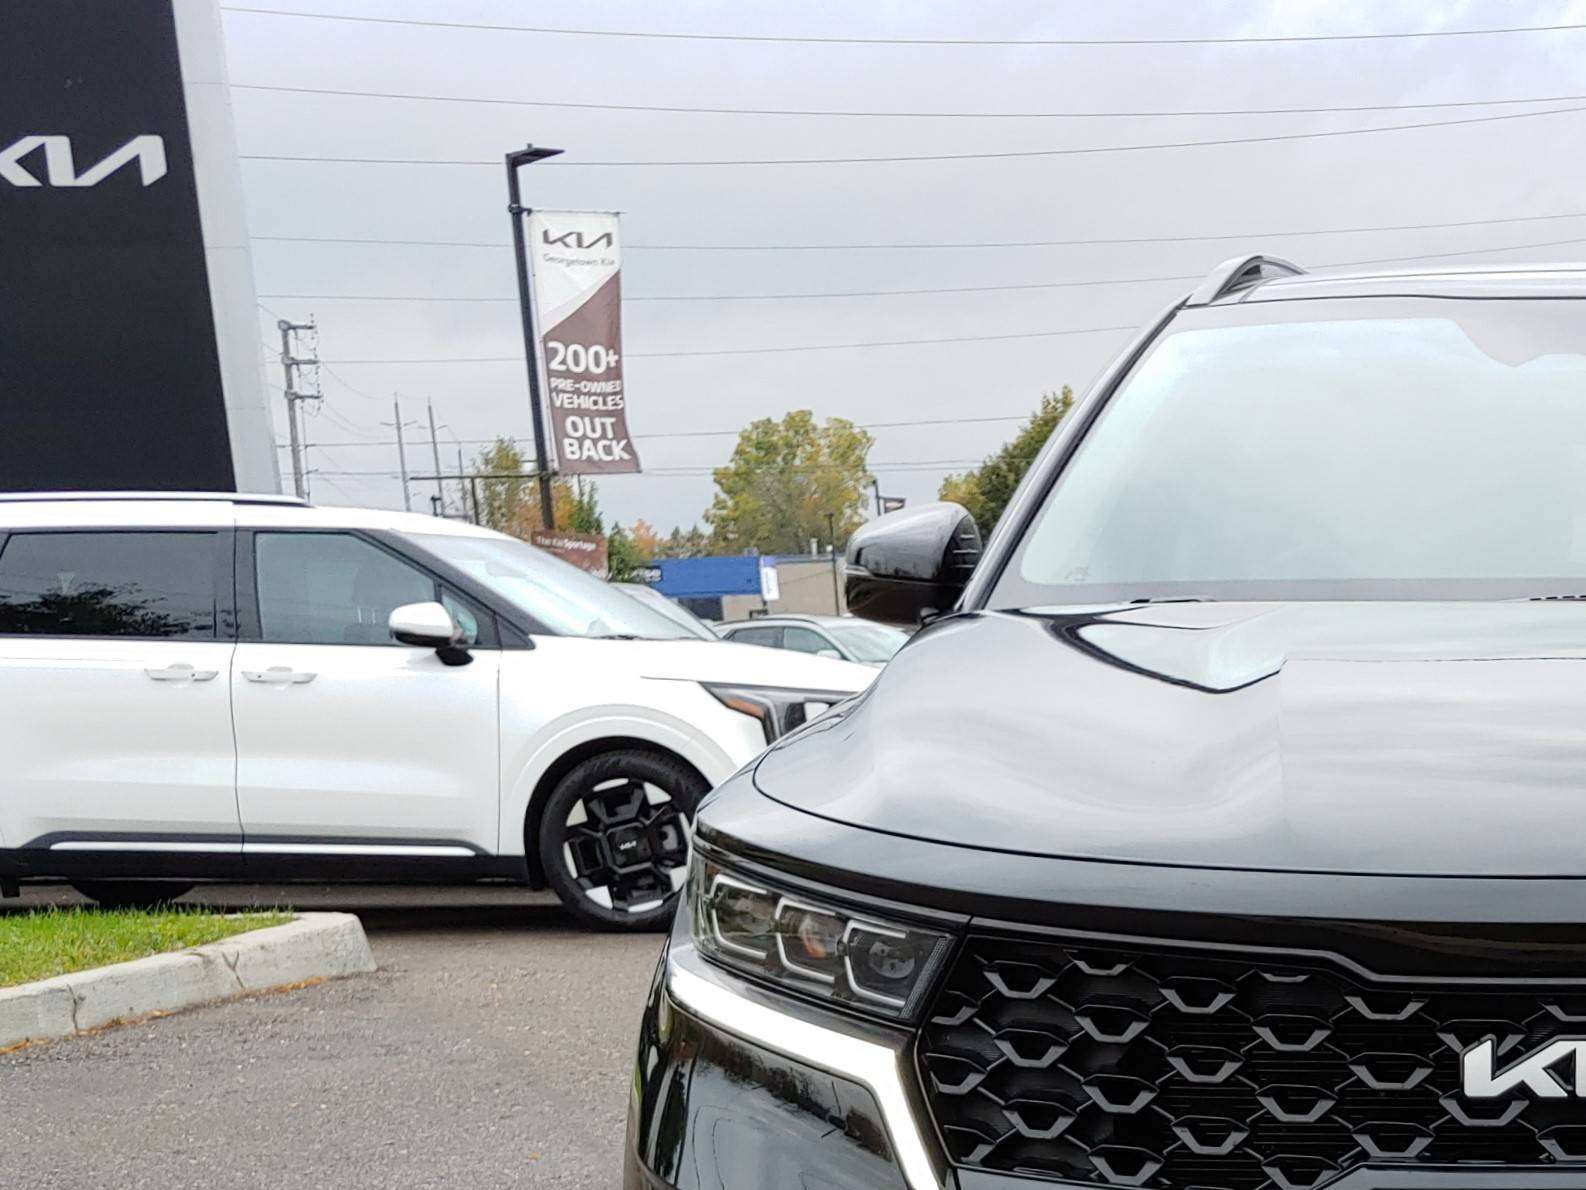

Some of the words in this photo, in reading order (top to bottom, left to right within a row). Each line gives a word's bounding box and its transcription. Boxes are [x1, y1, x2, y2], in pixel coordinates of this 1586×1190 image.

[543, 229, 613, 249] KIA
[547, 341, 619, 374] 200+
[550, 377, 622, 393] PRE-OWNED
[551, 392, 625, 410] VEHICLES
[565, 415, 616, 439] OUT
[563, 438, 632, 461] BACK
